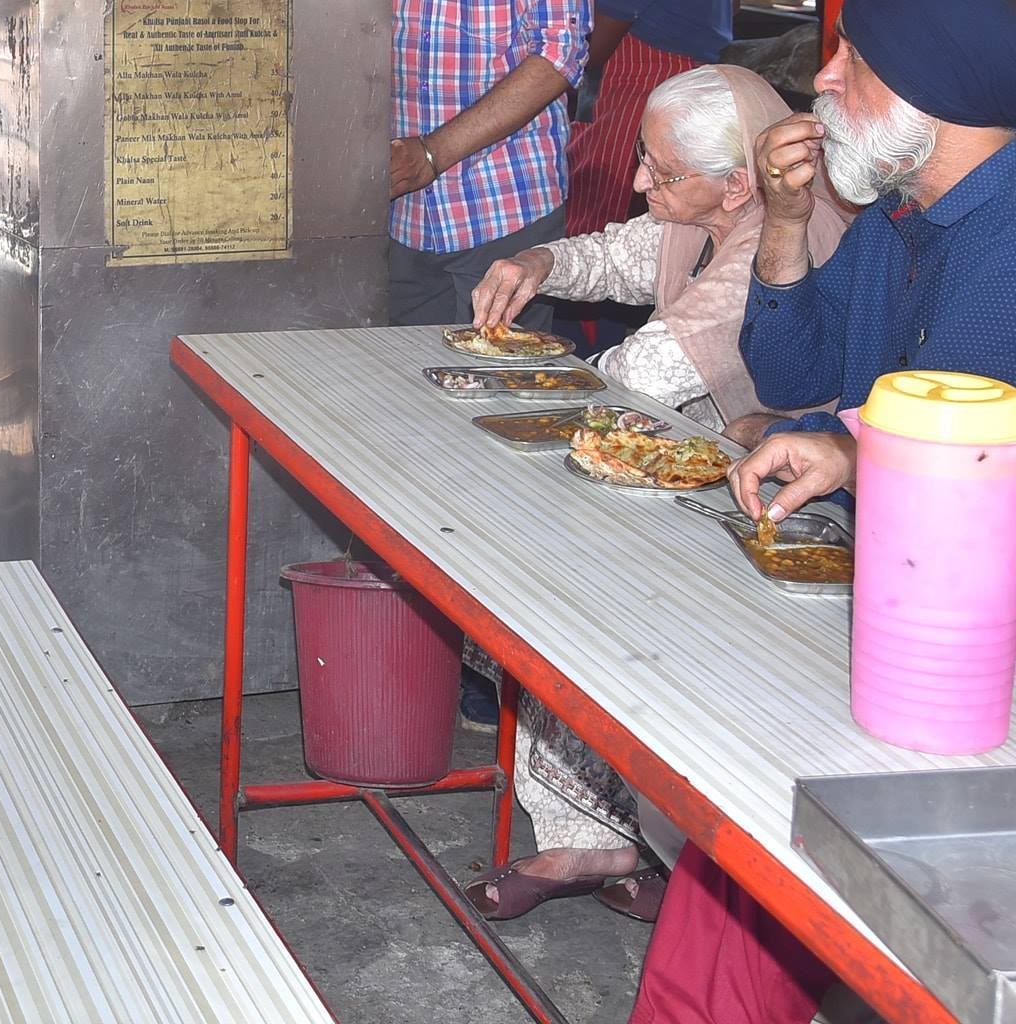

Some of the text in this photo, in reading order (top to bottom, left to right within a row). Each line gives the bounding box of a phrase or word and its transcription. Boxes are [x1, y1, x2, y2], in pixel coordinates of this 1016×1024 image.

[249, 16, 260, 25] For
[147, 30, 176, 39] Authentic
[178, 30, 195, 38] Taste
[134, 71, 164, 79] Makhan
[165, 70, 183, 78] Wala
[183, 70, 208, 78] Kulcha
[134, 91, 162, 100] Makhan
[164, 91, 182, 99] Wala
[171, 112, 189, 120] Wala
[190, 112, 214, 120] Kulcha
[188, 133, 206, 141] Wala
[116, 177, 135, 185] Plain
[136, 176, 155, 184] Naan
[116, 198, 144, 207] Mineral
[145, 197, 167, 205] Water
[116, 219, 131, 228] Soft
[132, 218, 153, 227] Drink
